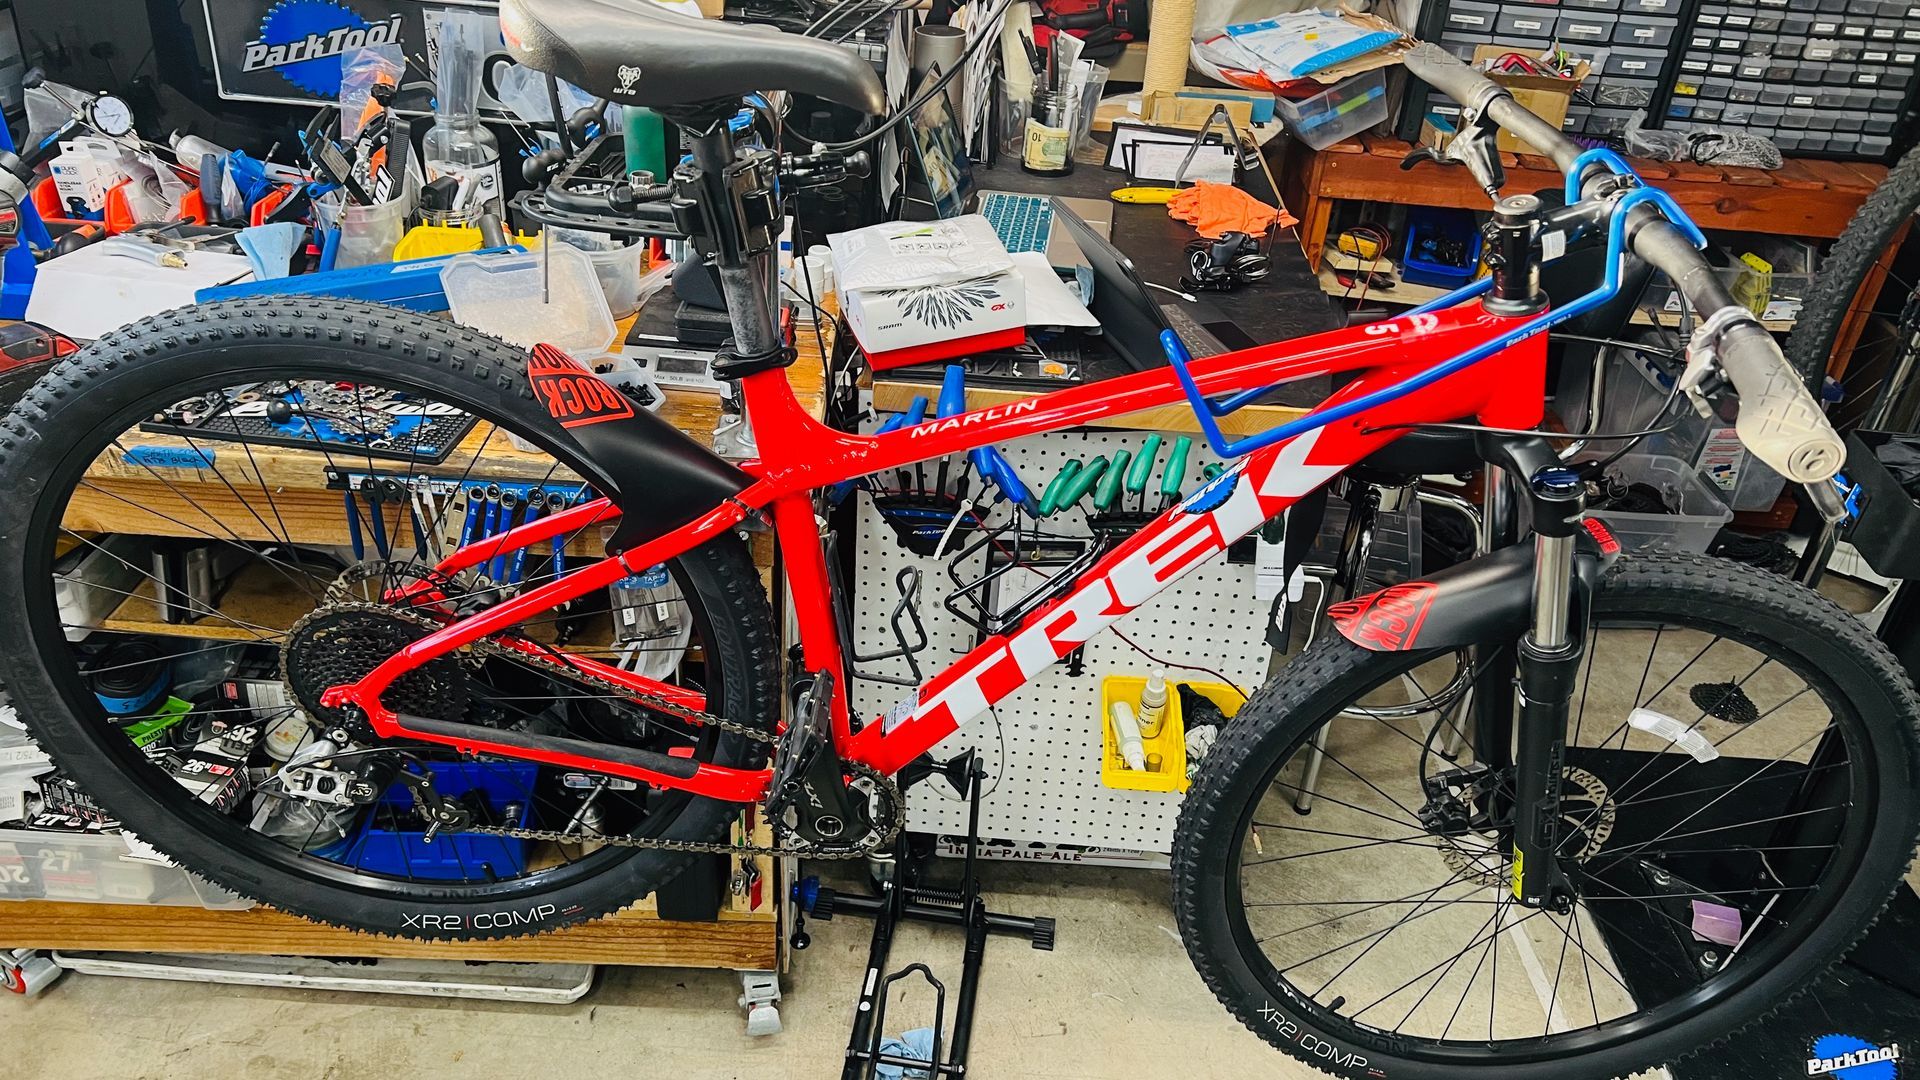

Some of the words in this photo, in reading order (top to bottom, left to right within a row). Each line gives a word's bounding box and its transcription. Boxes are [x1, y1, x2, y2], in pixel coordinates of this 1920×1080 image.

[243, 16, 402, 72] ParkTool
[539, 377, 622, 418] ROCK
[911, 399, 1039, 439] MARLIN
[913, 424, 1350, 728] TREK
[1358, 587, 1424, 652] ROCK
[948, 844, 993, 857] INIA
[1001, 848, 1043, 860] PALE
[1049, 850, 1083, 862] ALE
[401, 912, 463, 931] XR2
[473, 903, 557, 930] COMP
[1256, 999, 1299, 1040] XR2
[1300, 1032, 1369, 1069] COMP
[1806, 1042, 1901, 1076] ParkTool
